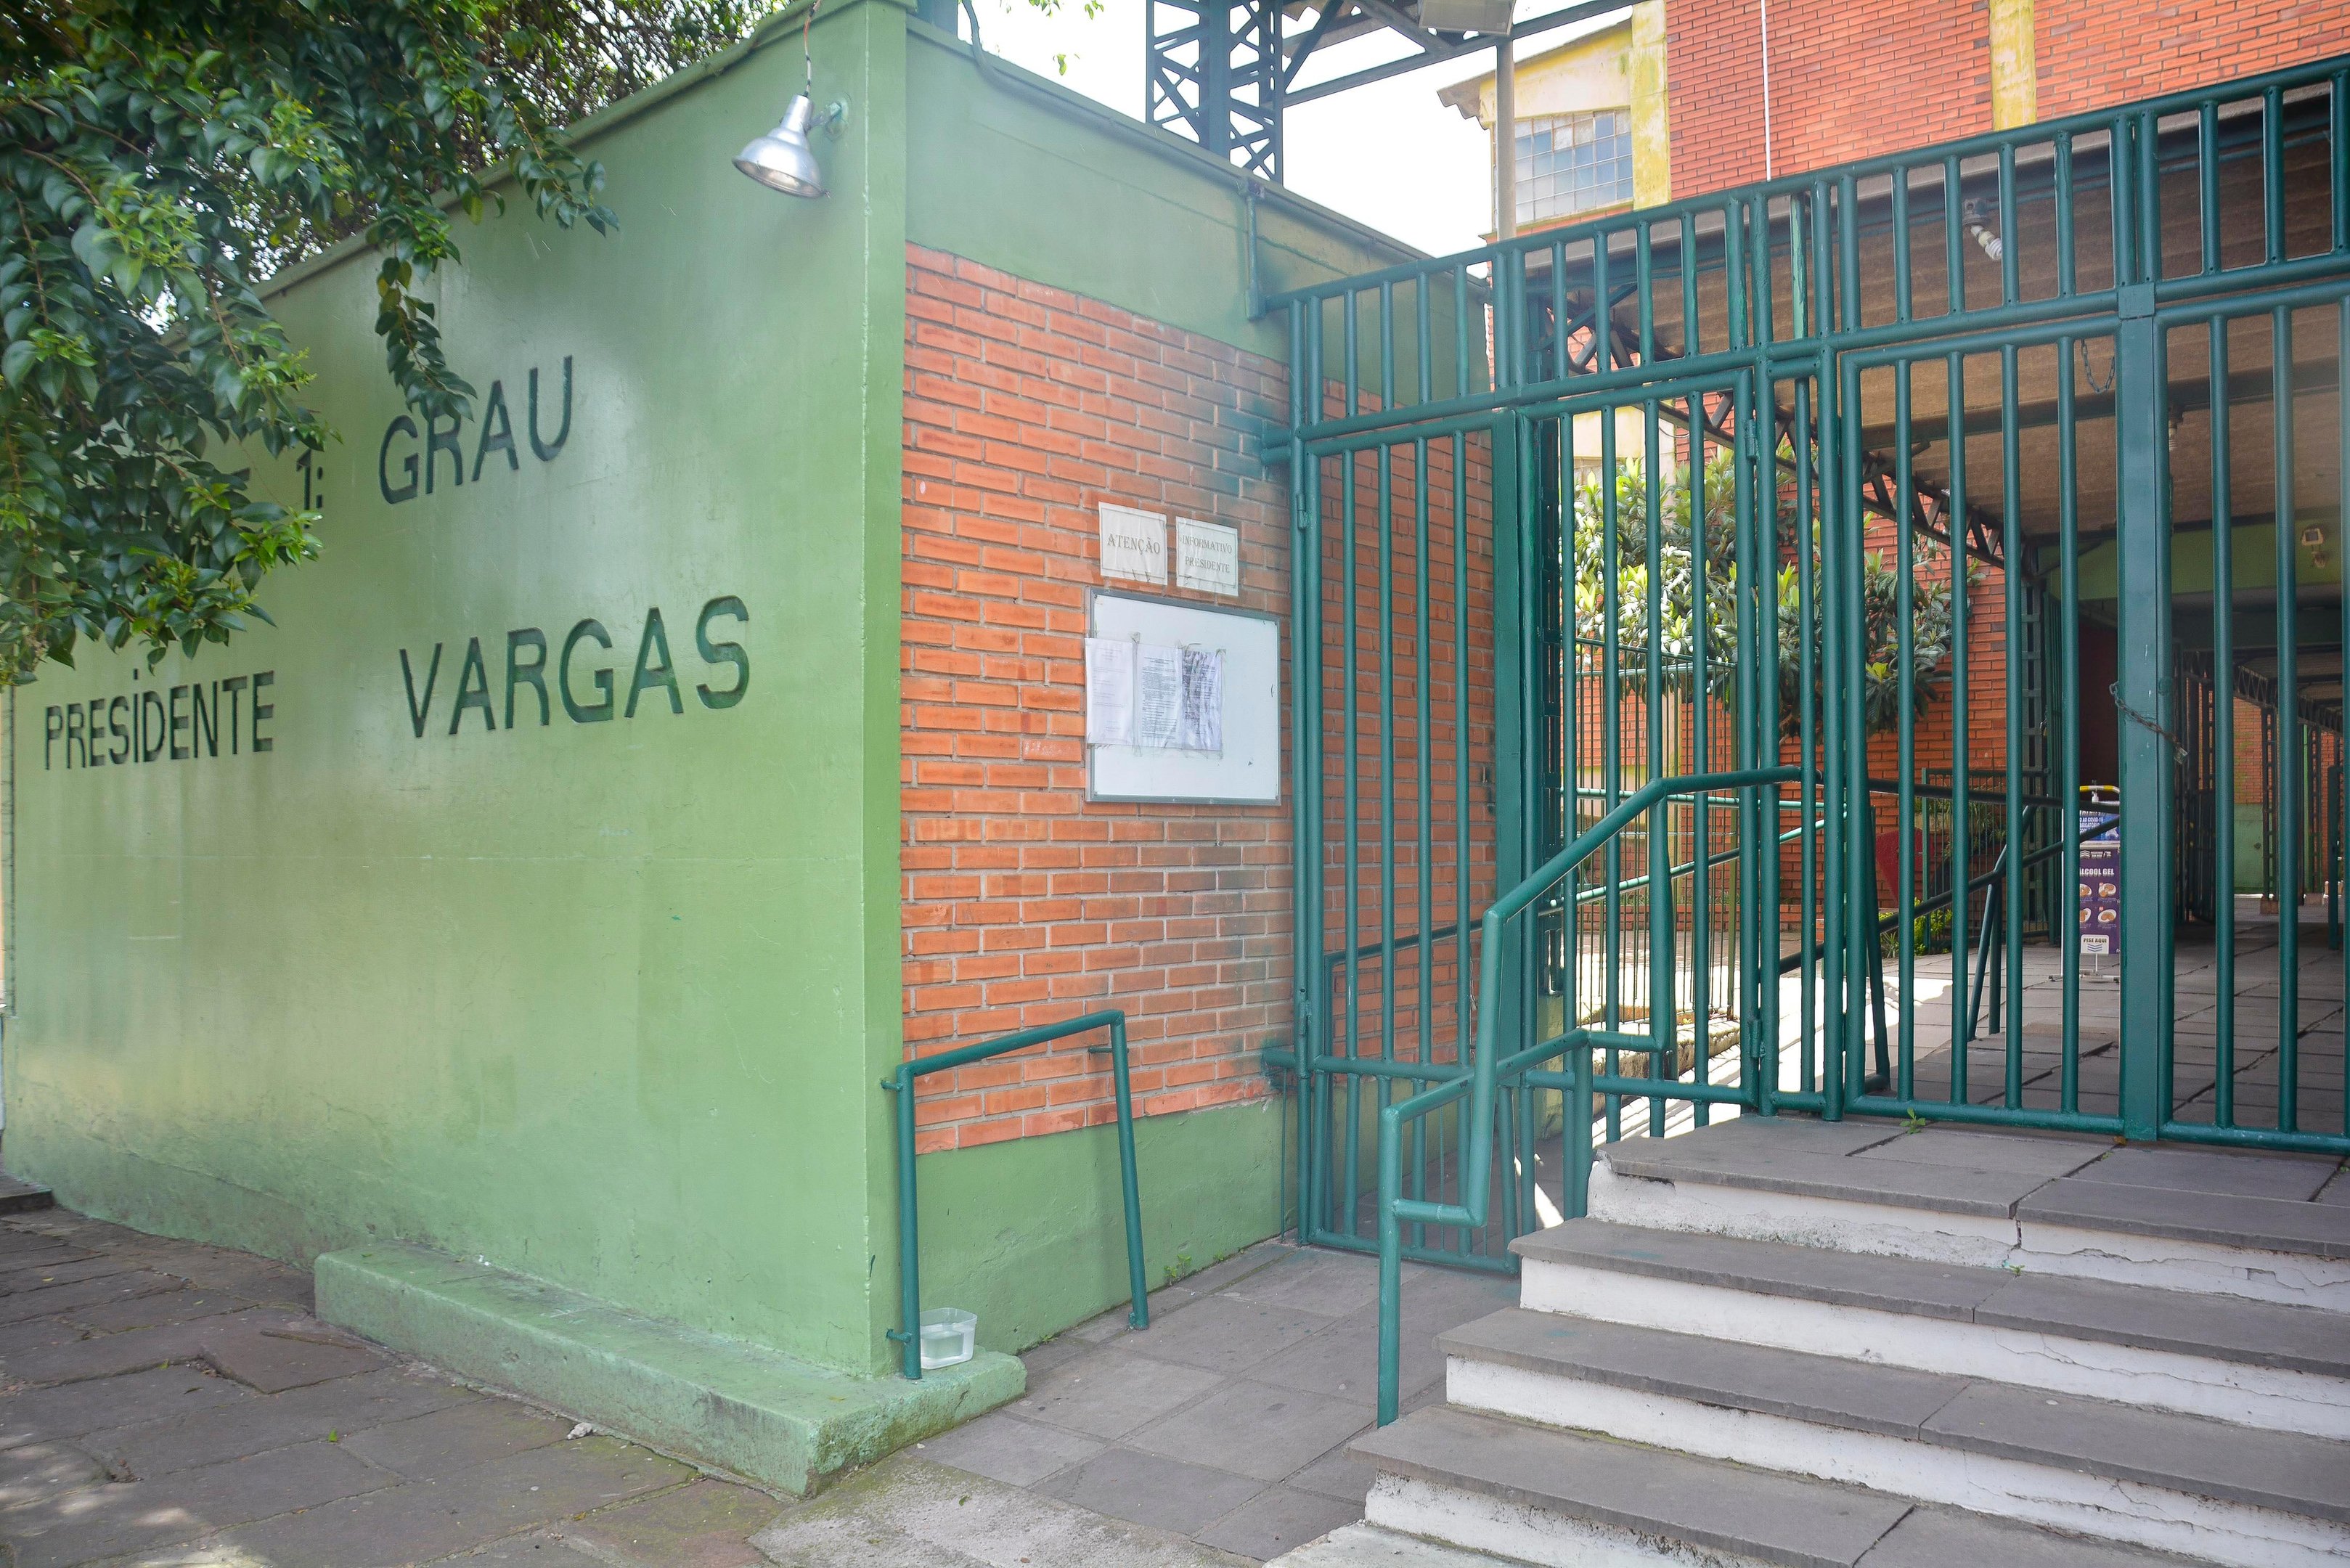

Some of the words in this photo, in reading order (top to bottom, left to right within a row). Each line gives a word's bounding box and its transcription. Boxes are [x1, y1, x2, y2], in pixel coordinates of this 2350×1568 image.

[378, 354, 574, 505] GRAU
[1106, 534, 1161, 555] ATENÇÃO
[1182, 535, 1233, 554] INFORMATIVO
[1185, 556, 1231, 573] PRESIDENTE
[45, 668, 275, 771] PRESIDENTE
[399, 595, 751, 738] VARGAS
